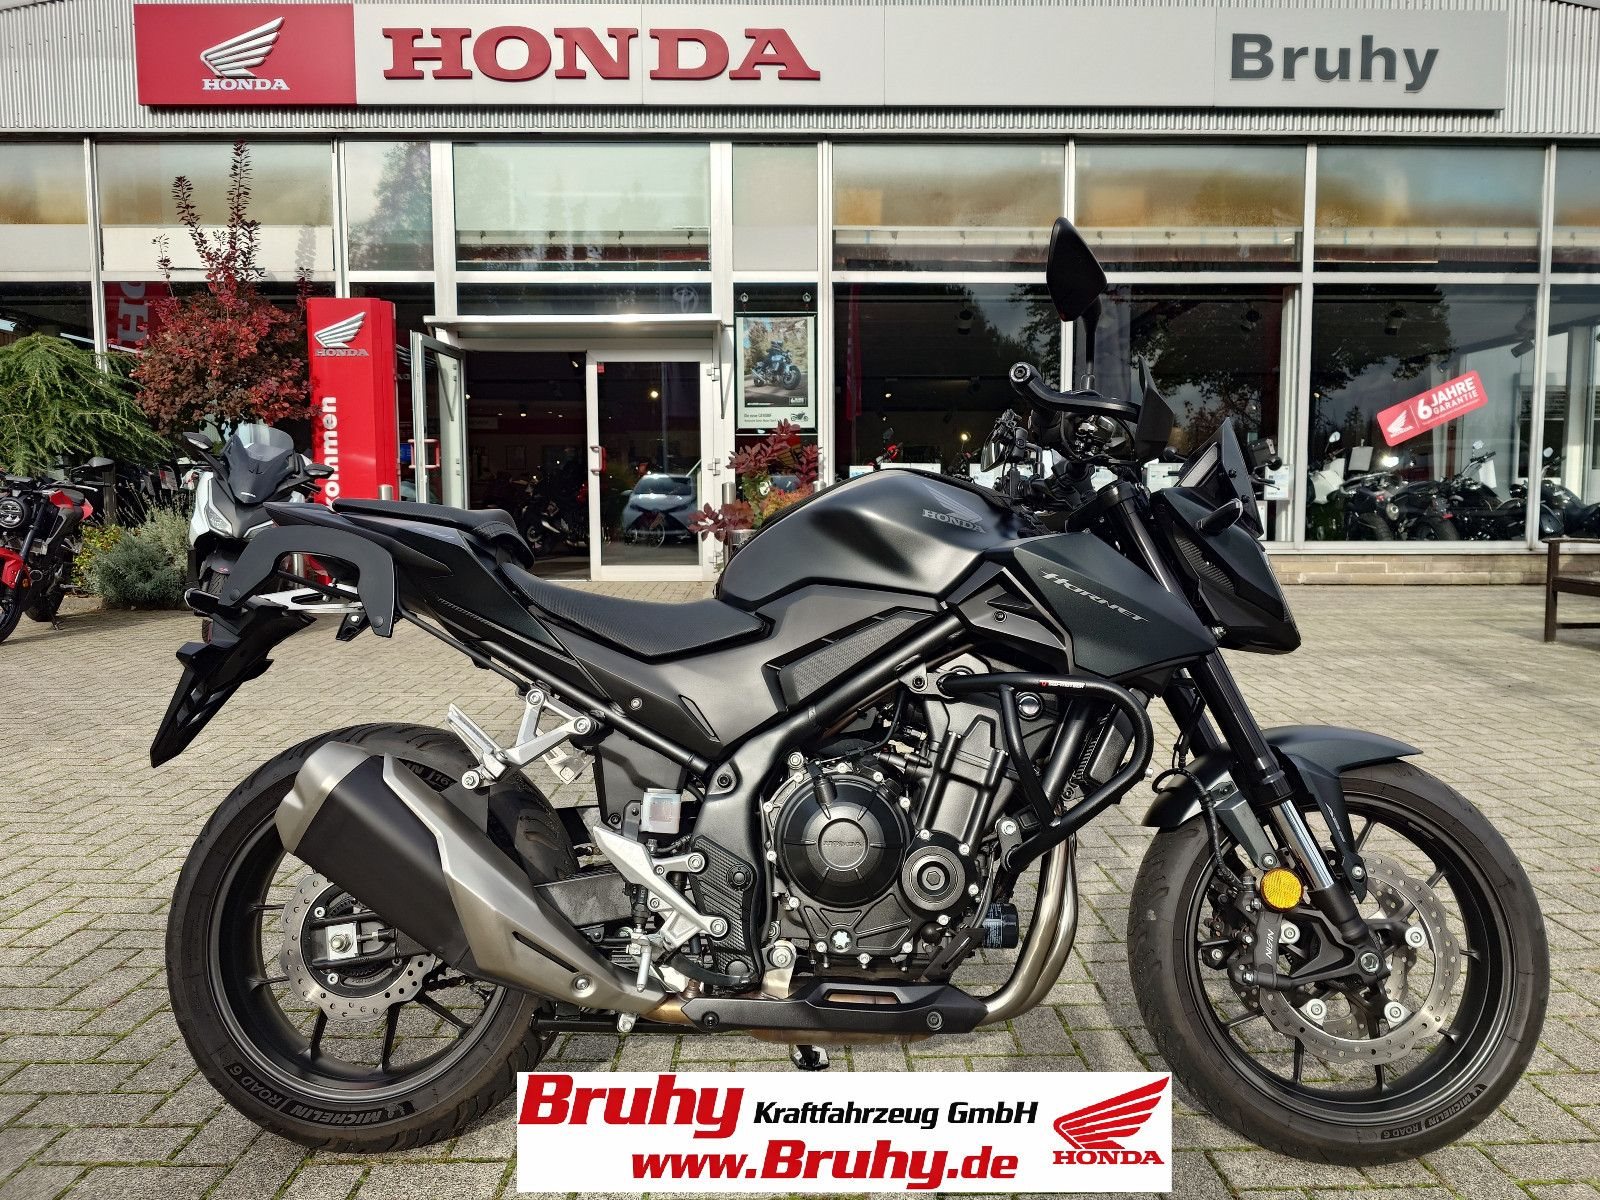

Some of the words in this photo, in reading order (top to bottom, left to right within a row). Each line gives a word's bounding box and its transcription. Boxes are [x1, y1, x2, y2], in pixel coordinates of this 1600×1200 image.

[382, 25, 820, 82] HONDA
[1231, 33, 1440, 93] Bruhy
[202, 79, 290, 91] HONDA
[314, 349, 370, 357] HONDA
[1417, 398, 1433, 420] 6
[1430, 377, 1476, 407] JAHRE
[1432, 389, 1479, 415] GARANTIE
[922, 508, 987, 534] HONDA
[229, 1064, 243, 1076] 6
[240, 1075, 283, 1106] ROAD
[290, 1104, 383, 1126] MICHELIN
[1427, 1094, 1473, 1126] MICHELIN
[1383, 1130, 1391, 1139] 6
[1392, 1123, 1419, 1137] ROAD
